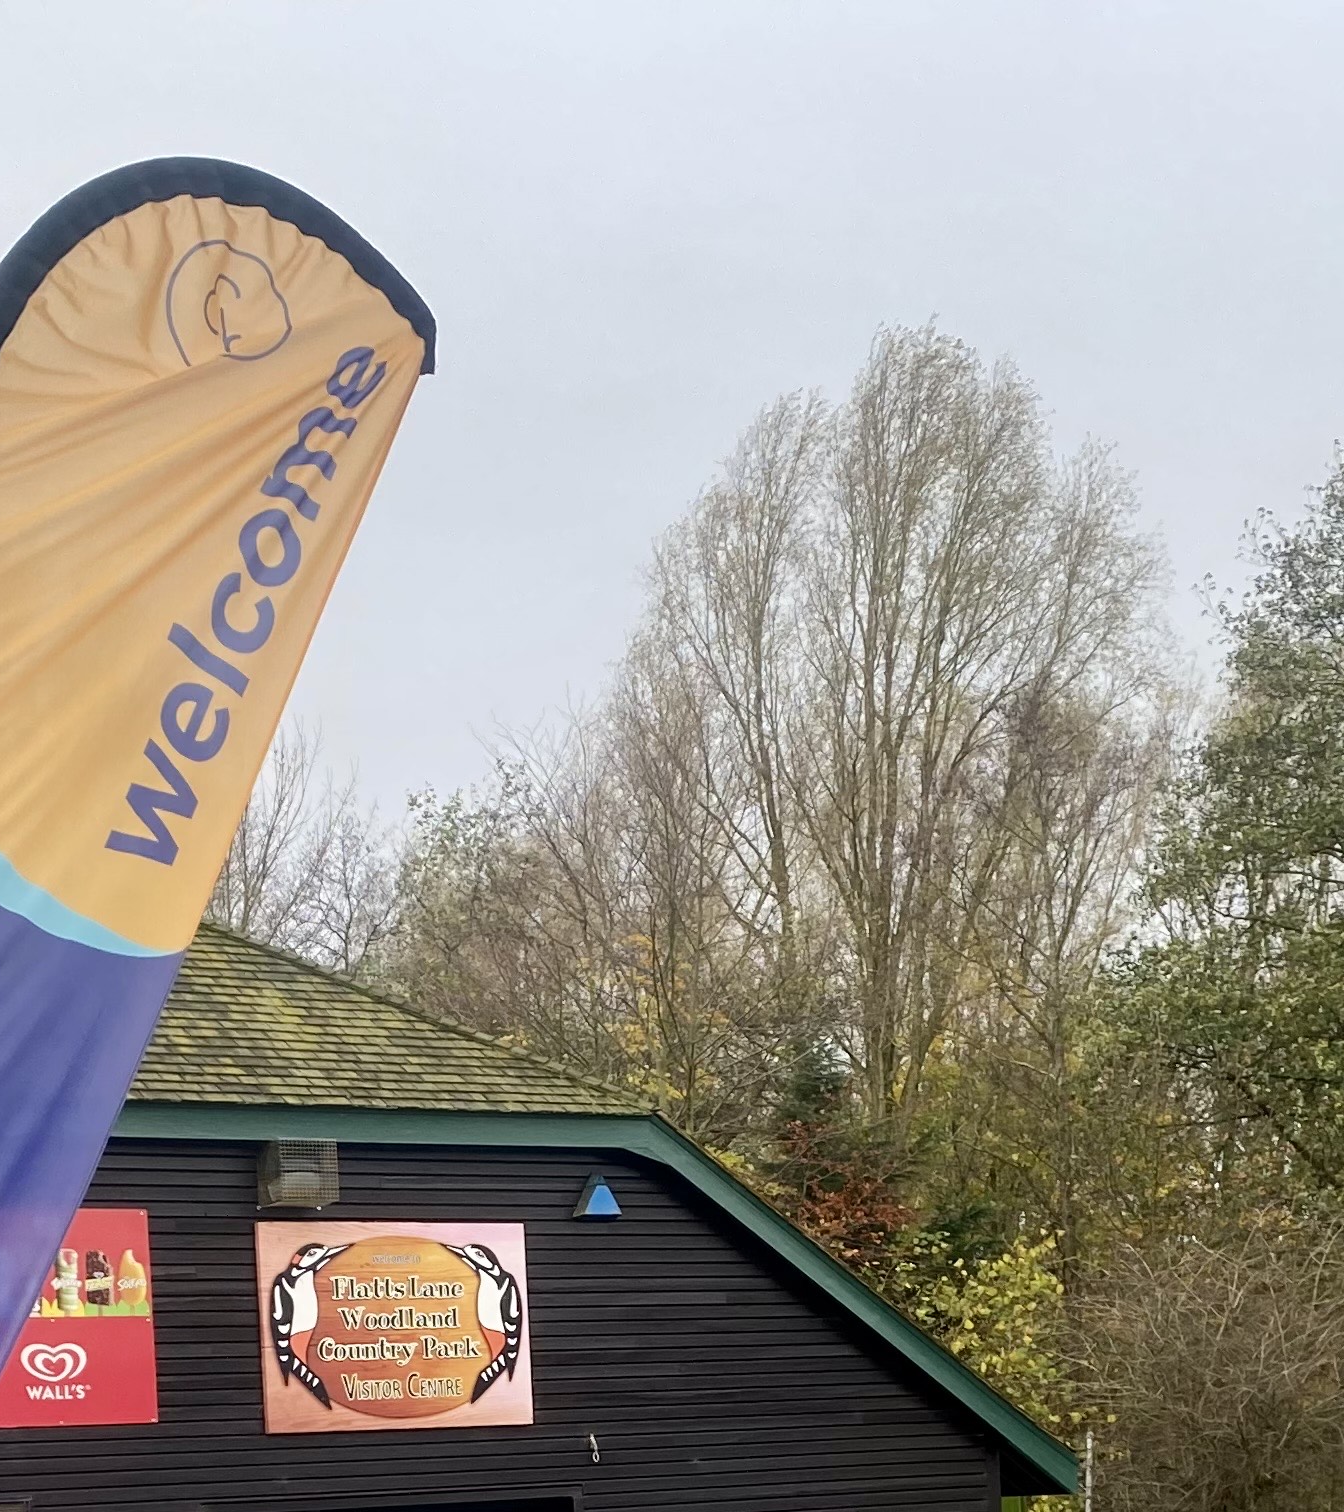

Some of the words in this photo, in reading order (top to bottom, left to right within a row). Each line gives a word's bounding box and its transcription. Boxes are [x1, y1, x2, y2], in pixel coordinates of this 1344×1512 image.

[104, 344, 389, 866] welcome
[330, 1275, 406, 1300] Flatts
[407, 1275, 465, 1300] Lane
[337, 1305, 461, 1331] Woodland
[317, 1337, 418, 1367] Country
[420, 1335, 483, 1361] Park
[25, 1384, 86, 1400] WALL'S
